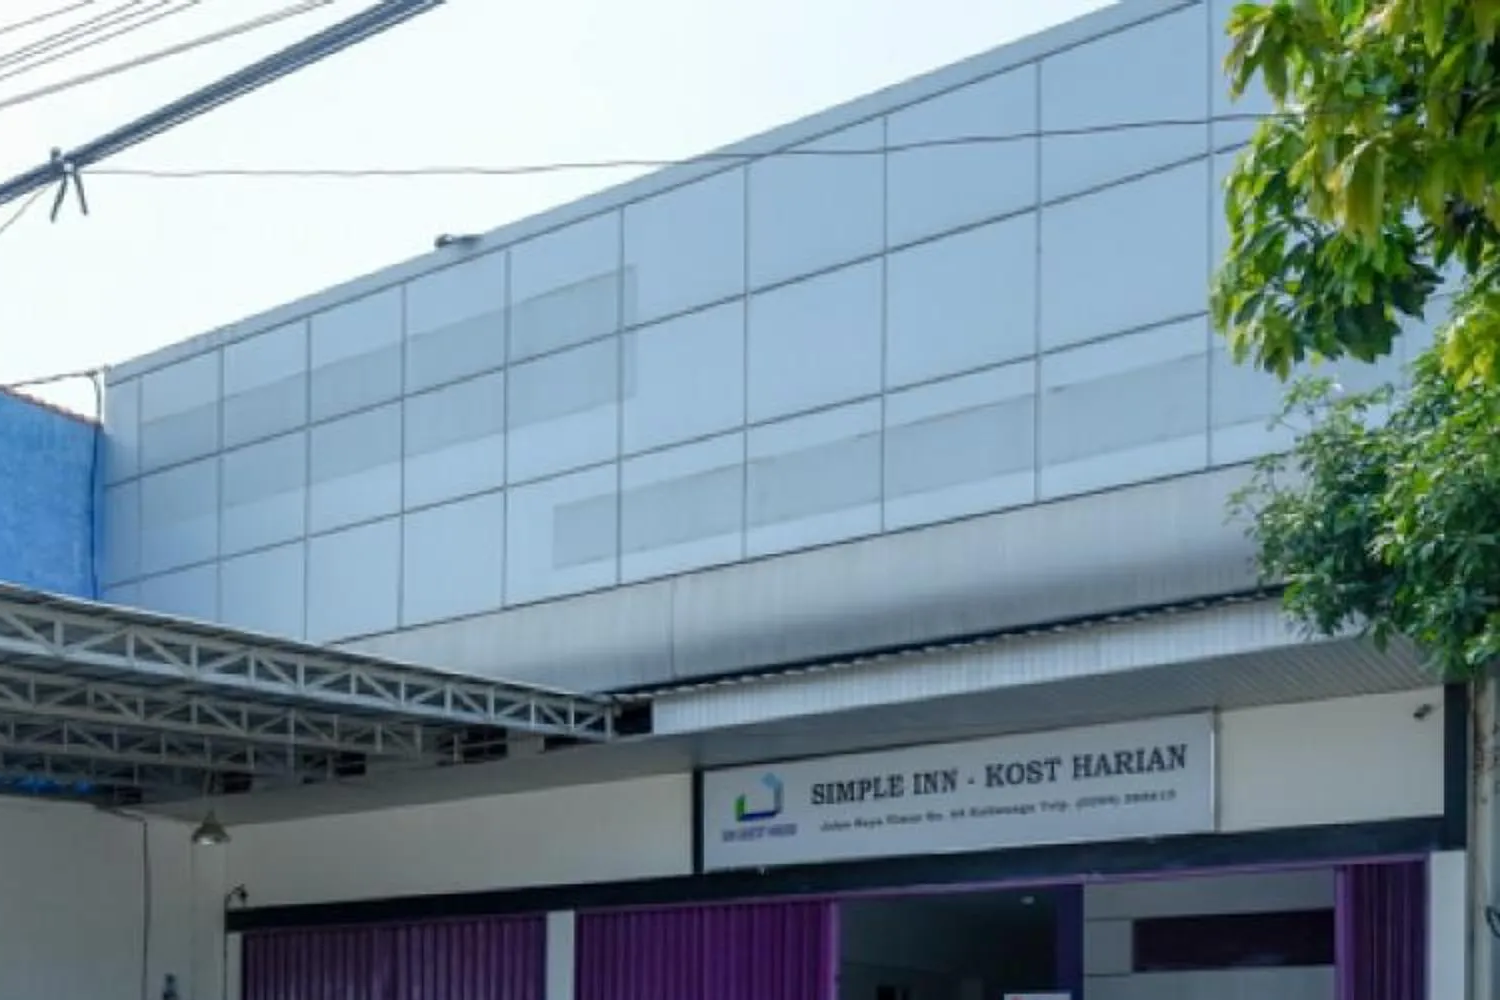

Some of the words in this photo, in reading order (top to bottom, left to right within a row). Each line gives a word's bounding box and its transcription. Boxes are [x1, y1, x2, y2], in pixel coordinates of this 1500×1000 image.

[811, 774, 904, 805] SIMPLE
[913, 769, 958, 795] INN
[985, 756, 1062, 787] KOST
[1072, 744, 1188, 780] HARIAN
